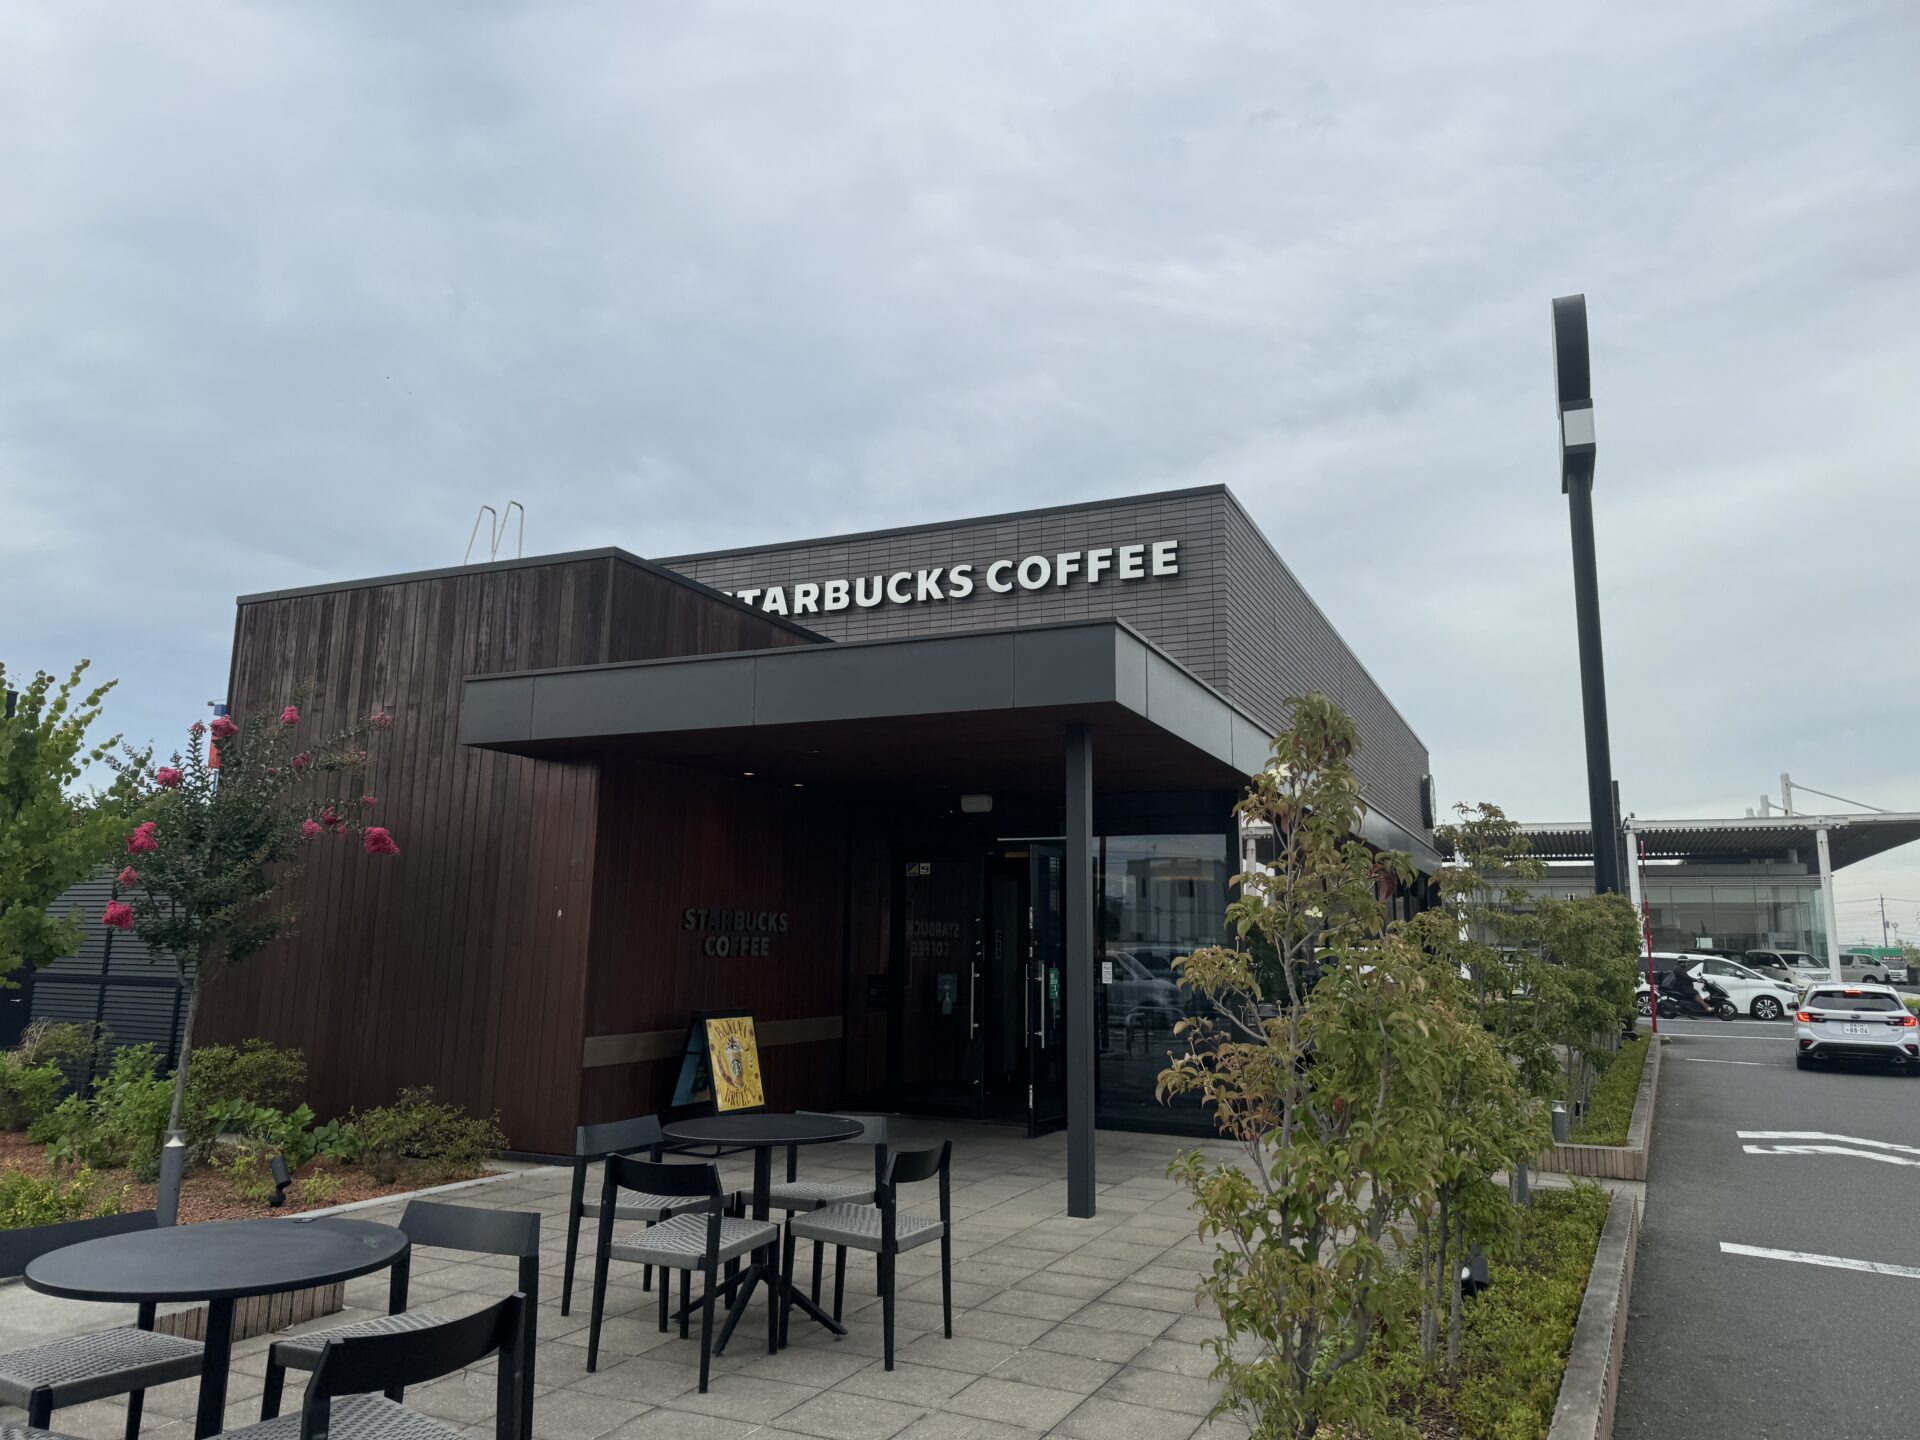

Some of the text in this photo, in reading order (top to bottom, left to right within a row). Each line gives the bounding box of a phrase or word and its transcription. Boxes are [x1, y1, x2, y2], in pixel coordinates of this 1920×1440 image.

[724, 539, 1179, 615] TARBUCKS COFFEE
[684, 907, 788, 932] STARBUCKS
[704, 935, 769, 957] COFFEE
[715, 1019, 747, 1040] BANANA
